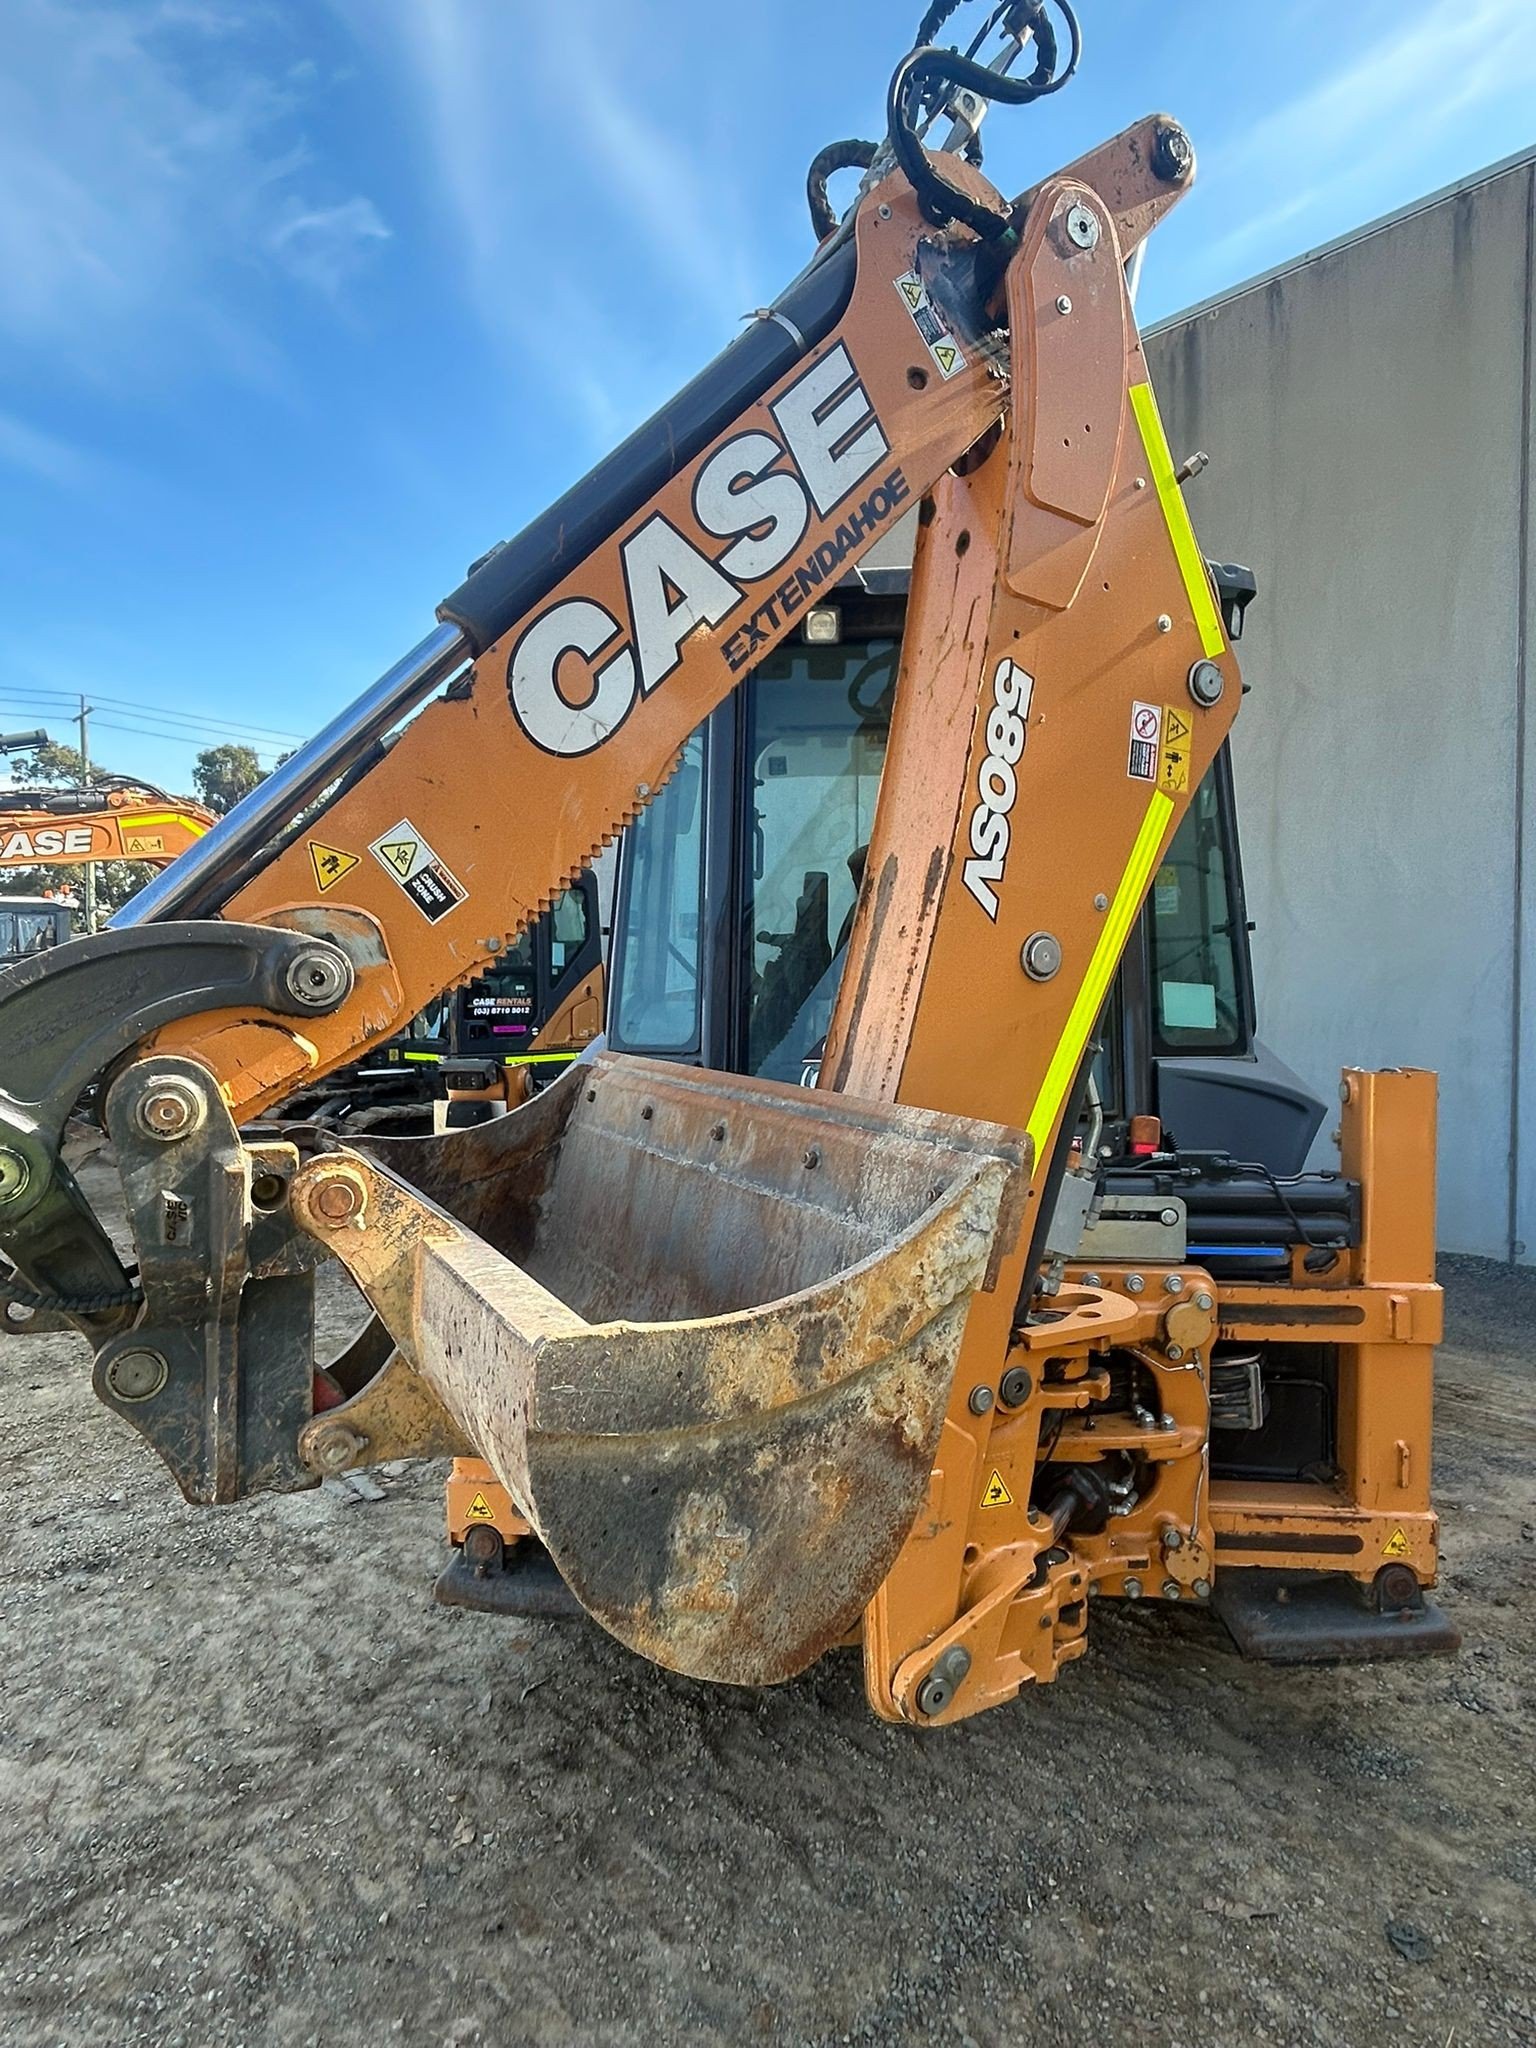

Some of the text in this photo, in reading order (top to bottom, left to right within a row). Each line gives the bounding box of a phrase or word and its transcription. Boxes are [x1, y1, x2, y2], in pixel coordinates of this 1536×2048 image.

[507, 337, 892, 758] CASE
[720, 467, 910, 673] EXTENDAHOE
[961, 657, 1035, 924] 580SV
[0, 827, 93, 860] ASE
[411, 878, 435, 904] ZONE
[420, 873, 447, 902] CRUSH
[472, 998, 532, 1006] CASE RENTALS
